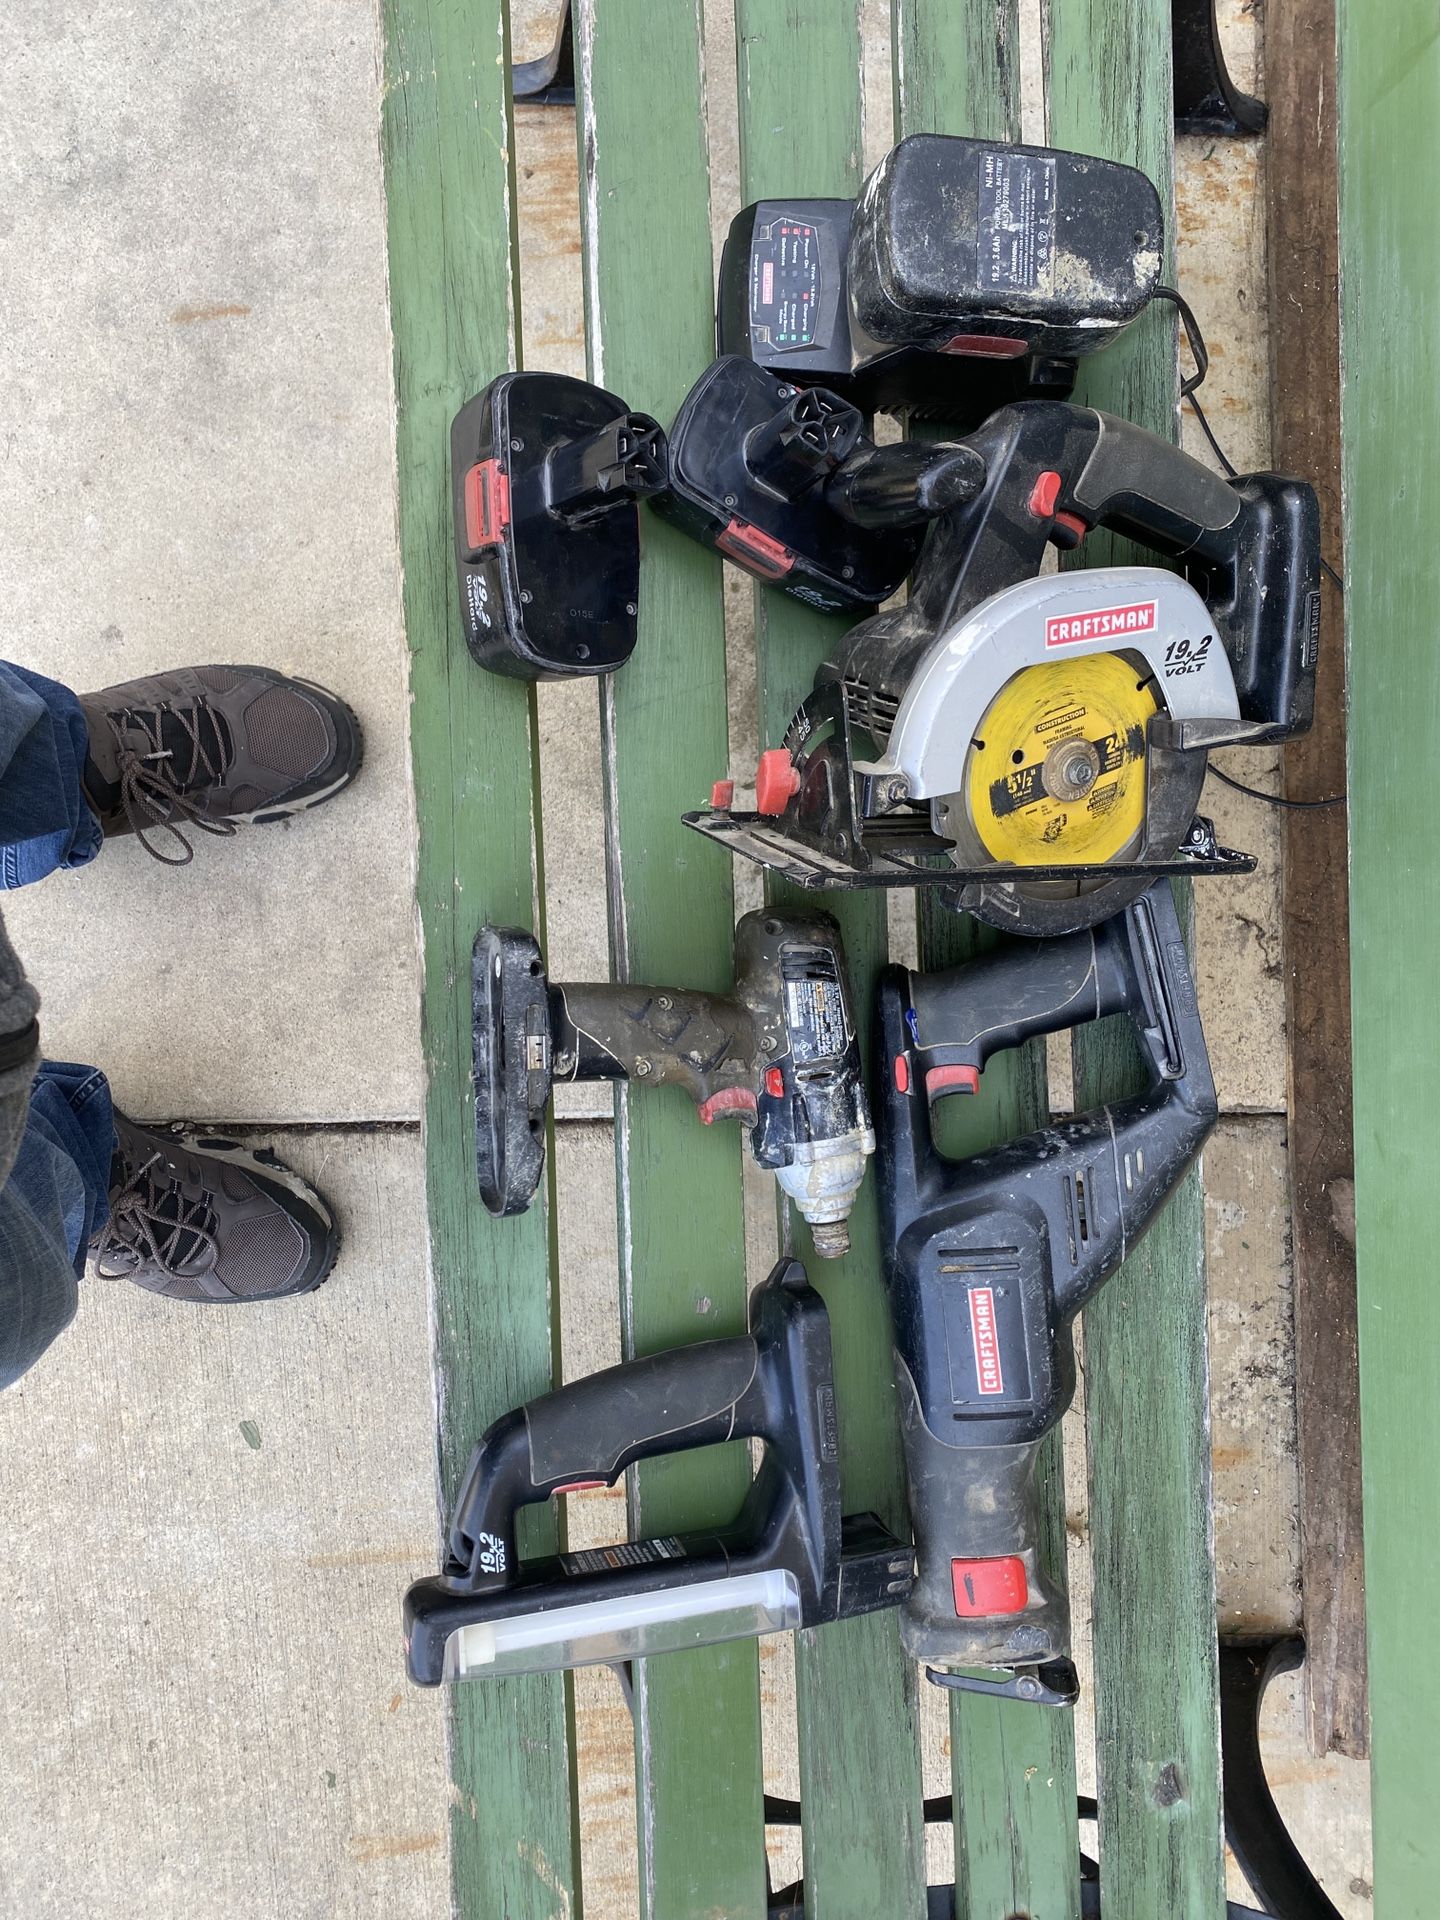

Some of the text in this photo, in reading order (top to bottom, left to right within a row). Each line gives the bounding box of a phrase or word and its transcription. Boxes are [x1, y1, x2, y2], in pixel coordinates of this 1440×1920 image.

[995, 157, 1003, 186] BATTERY
[994, 206, 1002, 230] POWER
[991, 236, 1001, 260] 3.6Ah
[804, 259, 810, 269] On
[466, 574, 478, 631] DieHard
[478, 575, 492, 628] 19.2
[1049, 609, 1149, 642] CRAFTSMAN
[1165, 635, 1214, 662] 19.2
[1166, 662, 1206, 678] VOLT
[798, 726, 807, 741] 45
[1037, 709, 1086, 731] CONSTRUCTION
[974, 1293, 998, 1389] CRAFTSMAN
[479, 1531, 496, 1574] 19.2
[497, 1537, 506, 1573] VOLT
